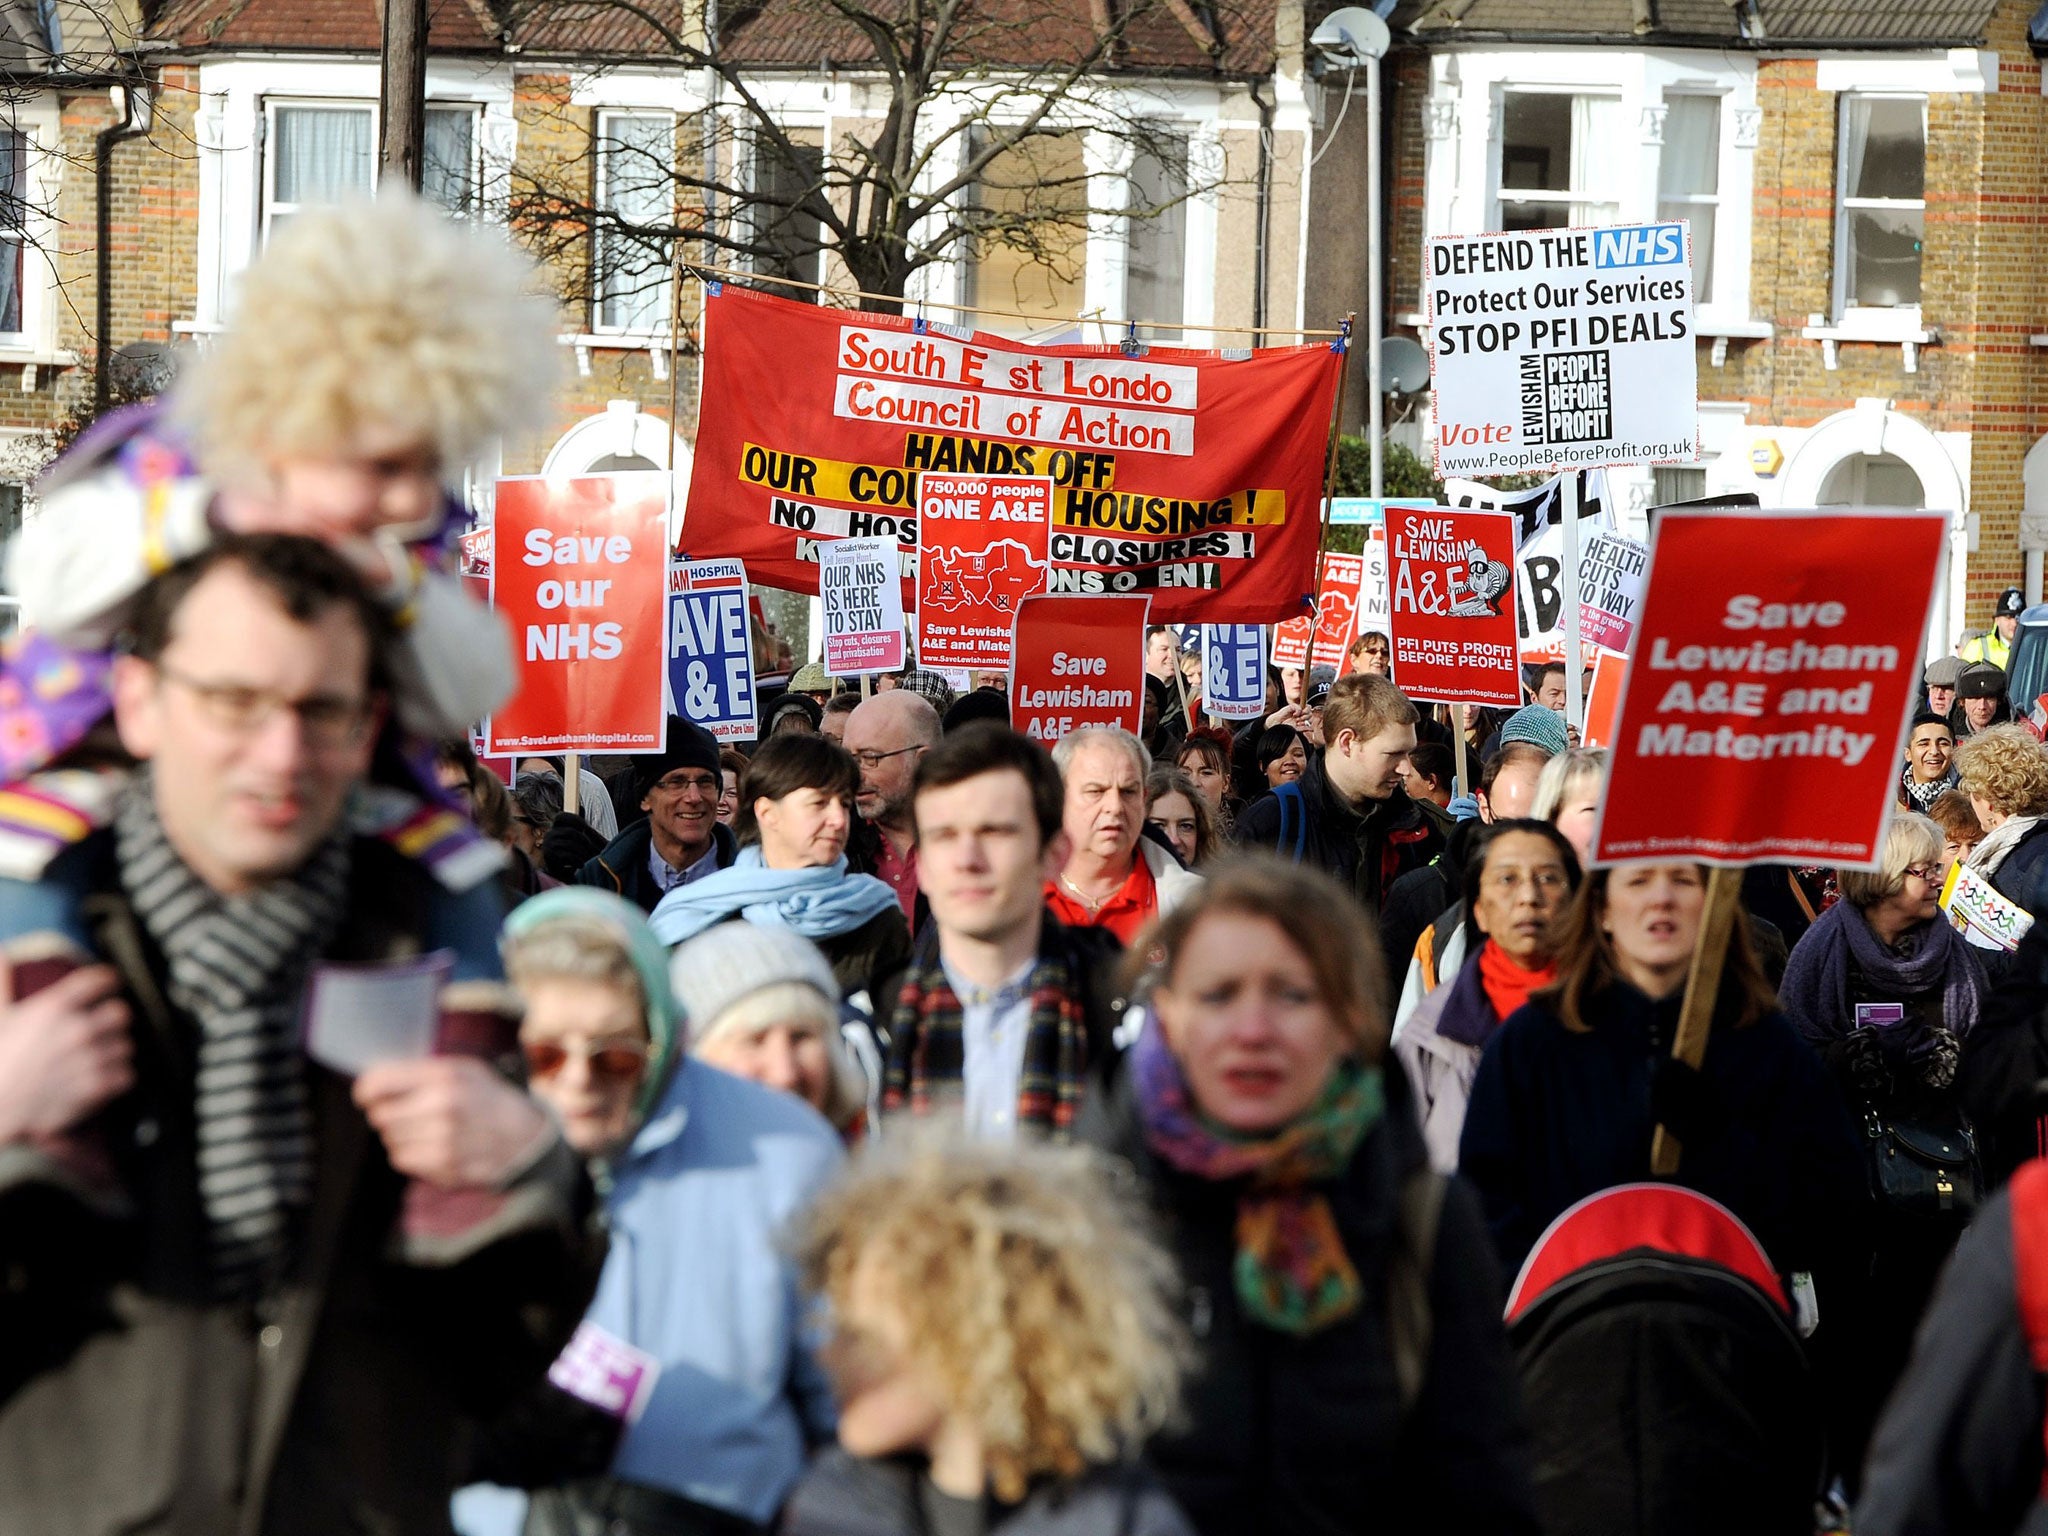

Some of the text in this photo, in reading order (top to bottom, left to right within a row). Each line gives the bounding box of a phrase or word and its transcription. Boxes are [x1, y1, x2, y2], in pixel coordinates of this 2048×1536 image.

[1434, 239, 1533, 276] DEFEND
[1540, 236, 1589, 268] THE
[1597, 227, 1681, 265] NHS
[1436, 286, 1528, 316] Protect
[1534, 282, 1579, 309] Our
[1586, 275, 1685, 306] Services
[1438, 310, 1687, 355] STOP PFI DEALS
[843, 332, 945, 379] South
[1547, 353, 1607, 383] PEOPLE
[1520, 354, 1544, 446] LEWISHAM
[1548, 381, 1608, 412] BEFORE
[848, 380, 1171, 451] Council of Action
[1550, 409, 1609, 441] PROFIT
[1441, 423, 1512, 447] Vote
[905, 434, 1116, 488] HANDS OFF
[1443, 439, 1692, 471] www.PeopleBeforeProfit.org.uk
[745, 447, 817, 496] OUR
[1066, 489, 1232, 535] HOUSING
[925, 480, 1045, 499] 750,000 people
[923, 497, 1045, 523] ONE A&E
[774, 499, 816, 531] NO
[1052, 532, 1230, 567] CLOSURES
[1405, 515, 1454, 541] SAVE
[522, 528, 632, 567] Save
[835, 543, 880, 553] Socialist Worker
[1394, 534, 1478, 563] LEWISHAM
[1584, 537, 1646, 577] HEALTH
[690, 564, 741, 579] HOSPITAL
[824, 565, 851, 588] OUR
[856, 562, 886, 585] NHS
[1578, 559, 1623, 591] CUTS
[535, 579, 612, 609] our
[825, 586, 880, 611] IS HERE
[1394, 559, 1465, 616] A&E
[1599, 588, 1635, 618] WAY
[1722, 593, 1847, 630] Save
[670, 594, 746, 659] AVE
[827, 609, 883, 633] TO STAY
[926, 624, 1012, 637] Save Lewisha
[1600, 614, 1626, 633] greedy
[526, 622, 623, 662] NHS
[828, 637, 843, 648] Stop
[861, 634, 892, 645] closures
[829, 646, 884, 660] and privatisation
[922, 638, 1011, 652] A&E and Mate
[1397, 637, 1513, 658] PFI PUTS PROFIT
[1648, 637, 1899, 673] Lewisham
[923, 654, 1010, 666] www.SaveLewishamHosp
[1051, 651, 1107, 676] Save
[1399, 650, 1514, 671] BEFORE PEOPLE
[1019, 685, 1133, 708] Lewisham
[1398, 684, 1516, 700] www.SaveLewishamHospital.com
[1655, 679, 1875, 717] A&E and
[495, 732, 655, 747] www.SaveLewishamHospital.com
[1026, 717, 1072, 740] A&E
[1636, 722, 1876, 767] Maternity
